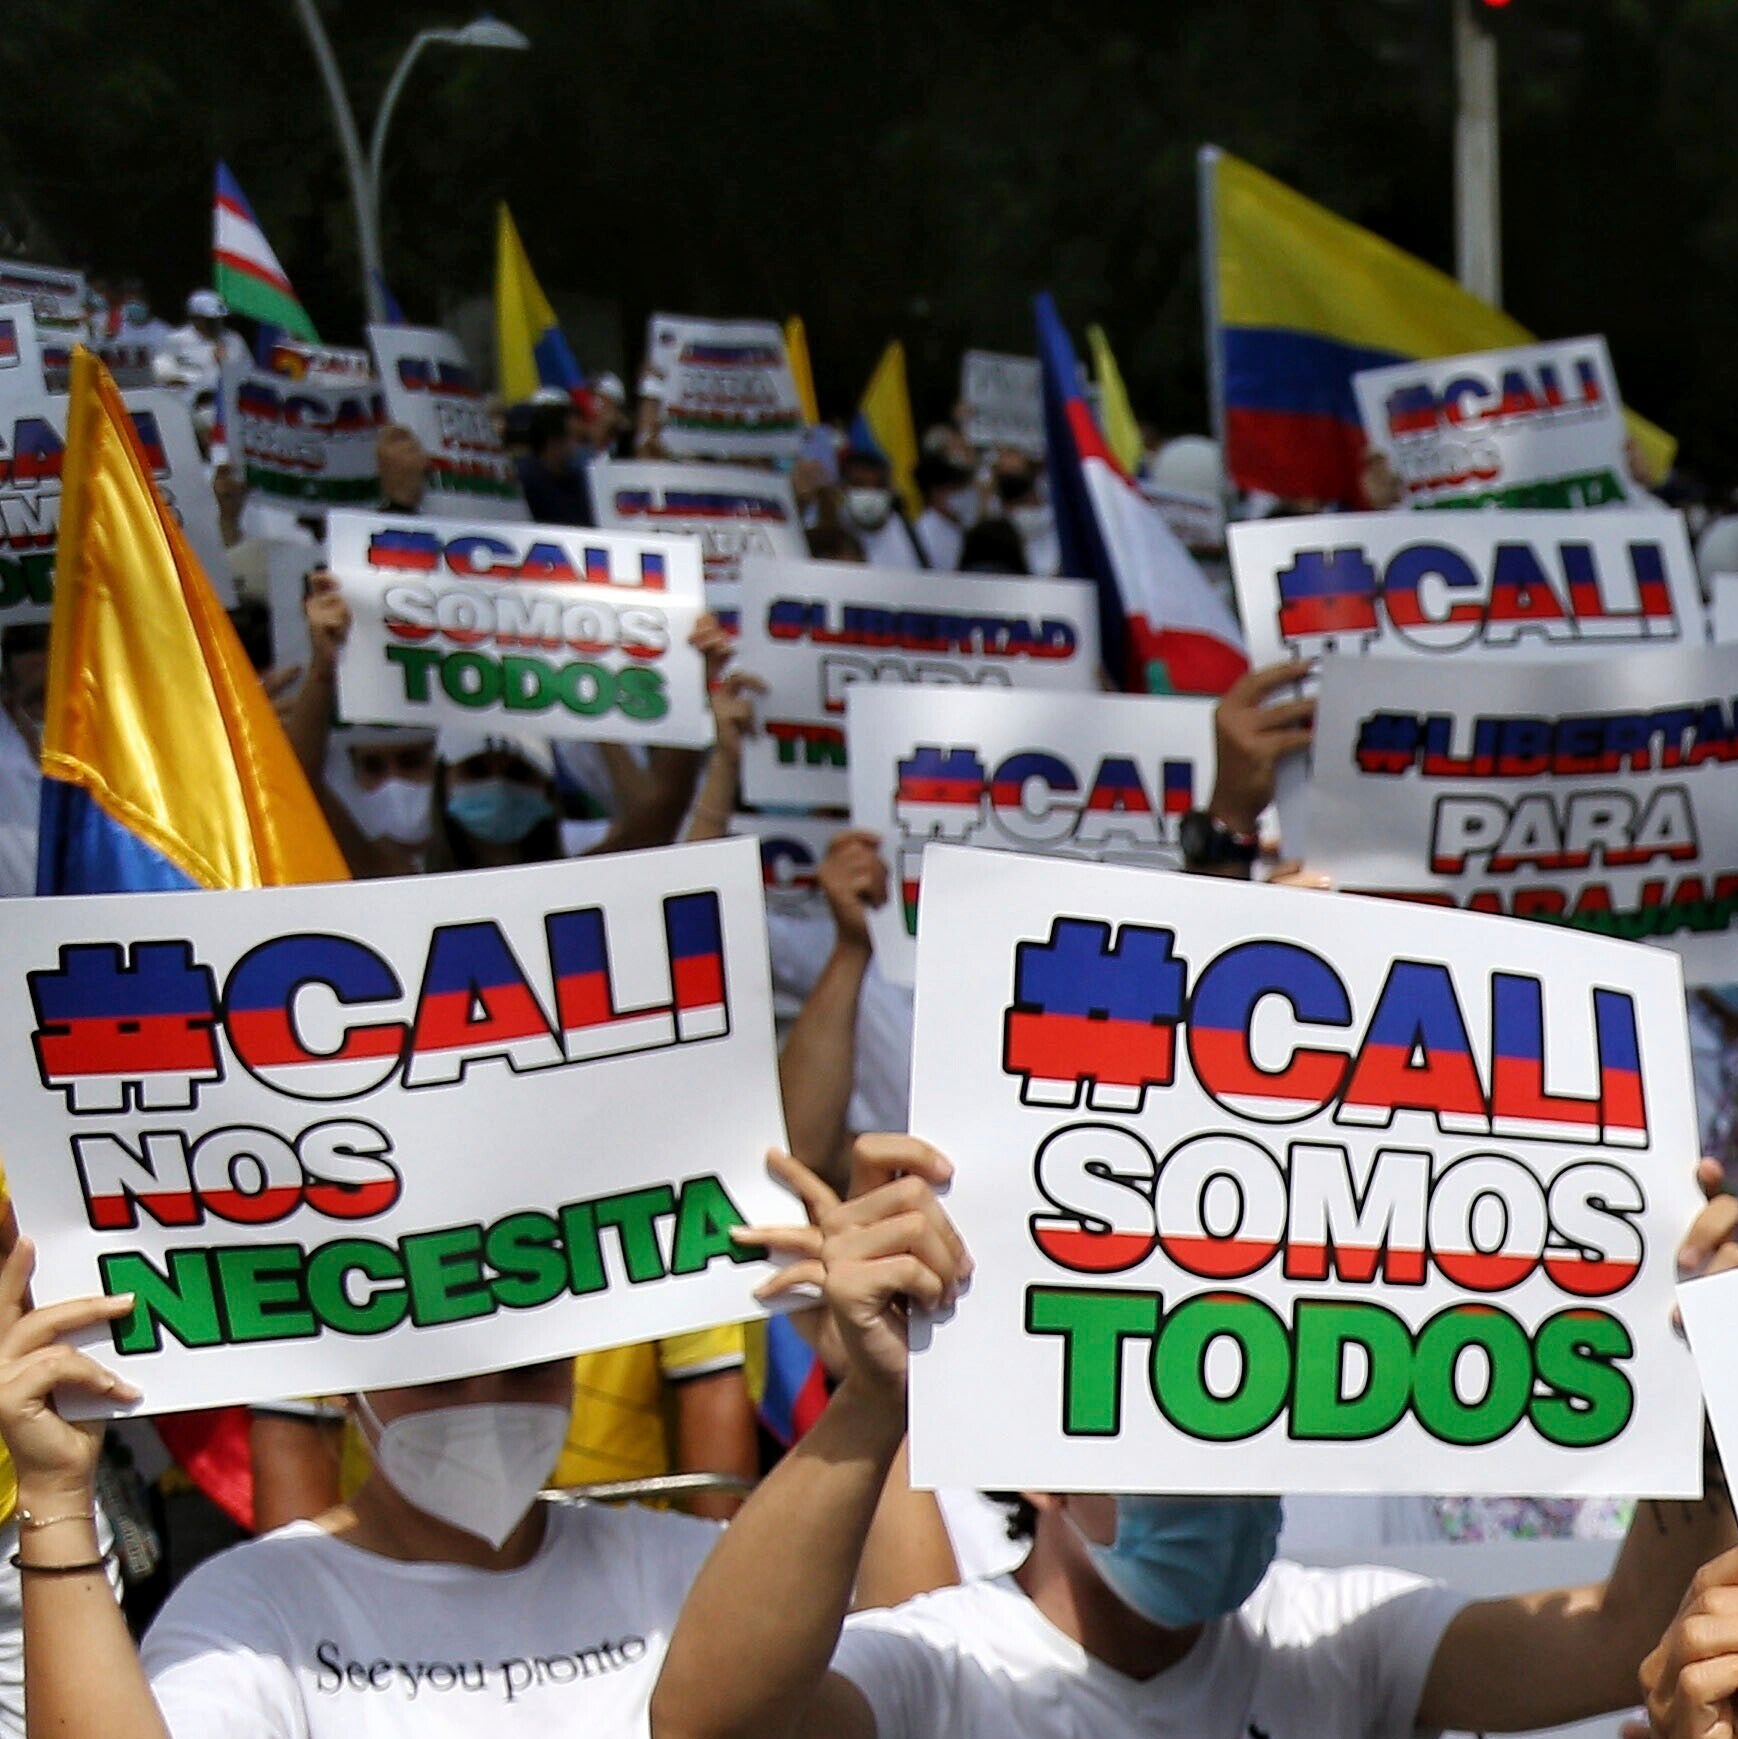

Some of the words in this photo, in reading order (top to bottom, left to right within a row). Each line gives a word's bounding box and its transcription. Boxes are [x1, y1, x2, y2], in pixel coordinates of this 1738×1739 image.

[1386, 357, 1602, 440] #CALI
[367, 527, 666, 594] #CALI
[1274, 538, 1684, 652] #CALI
[384, 586, 674, 664] SOMOS
[385, 643, 672, 722] TODOS
[1426, 782, 1702, 878] PARA
[27, 890, 731, 1114] #CALI
[1003, 914, 1649, 1150] #CALI
[70, 1118, 402, 1232] NOS
[1028, 1121, 1648, 1298] SOMOS
[98, 1172, 769, 1356] NECESITA
[1025, 1283, 1636, 1449] TODOS
[314, 1637, 394, 1695] See
[398, 1657, 487, 1701] you
[499, 1633, 647, 1704] pronto
